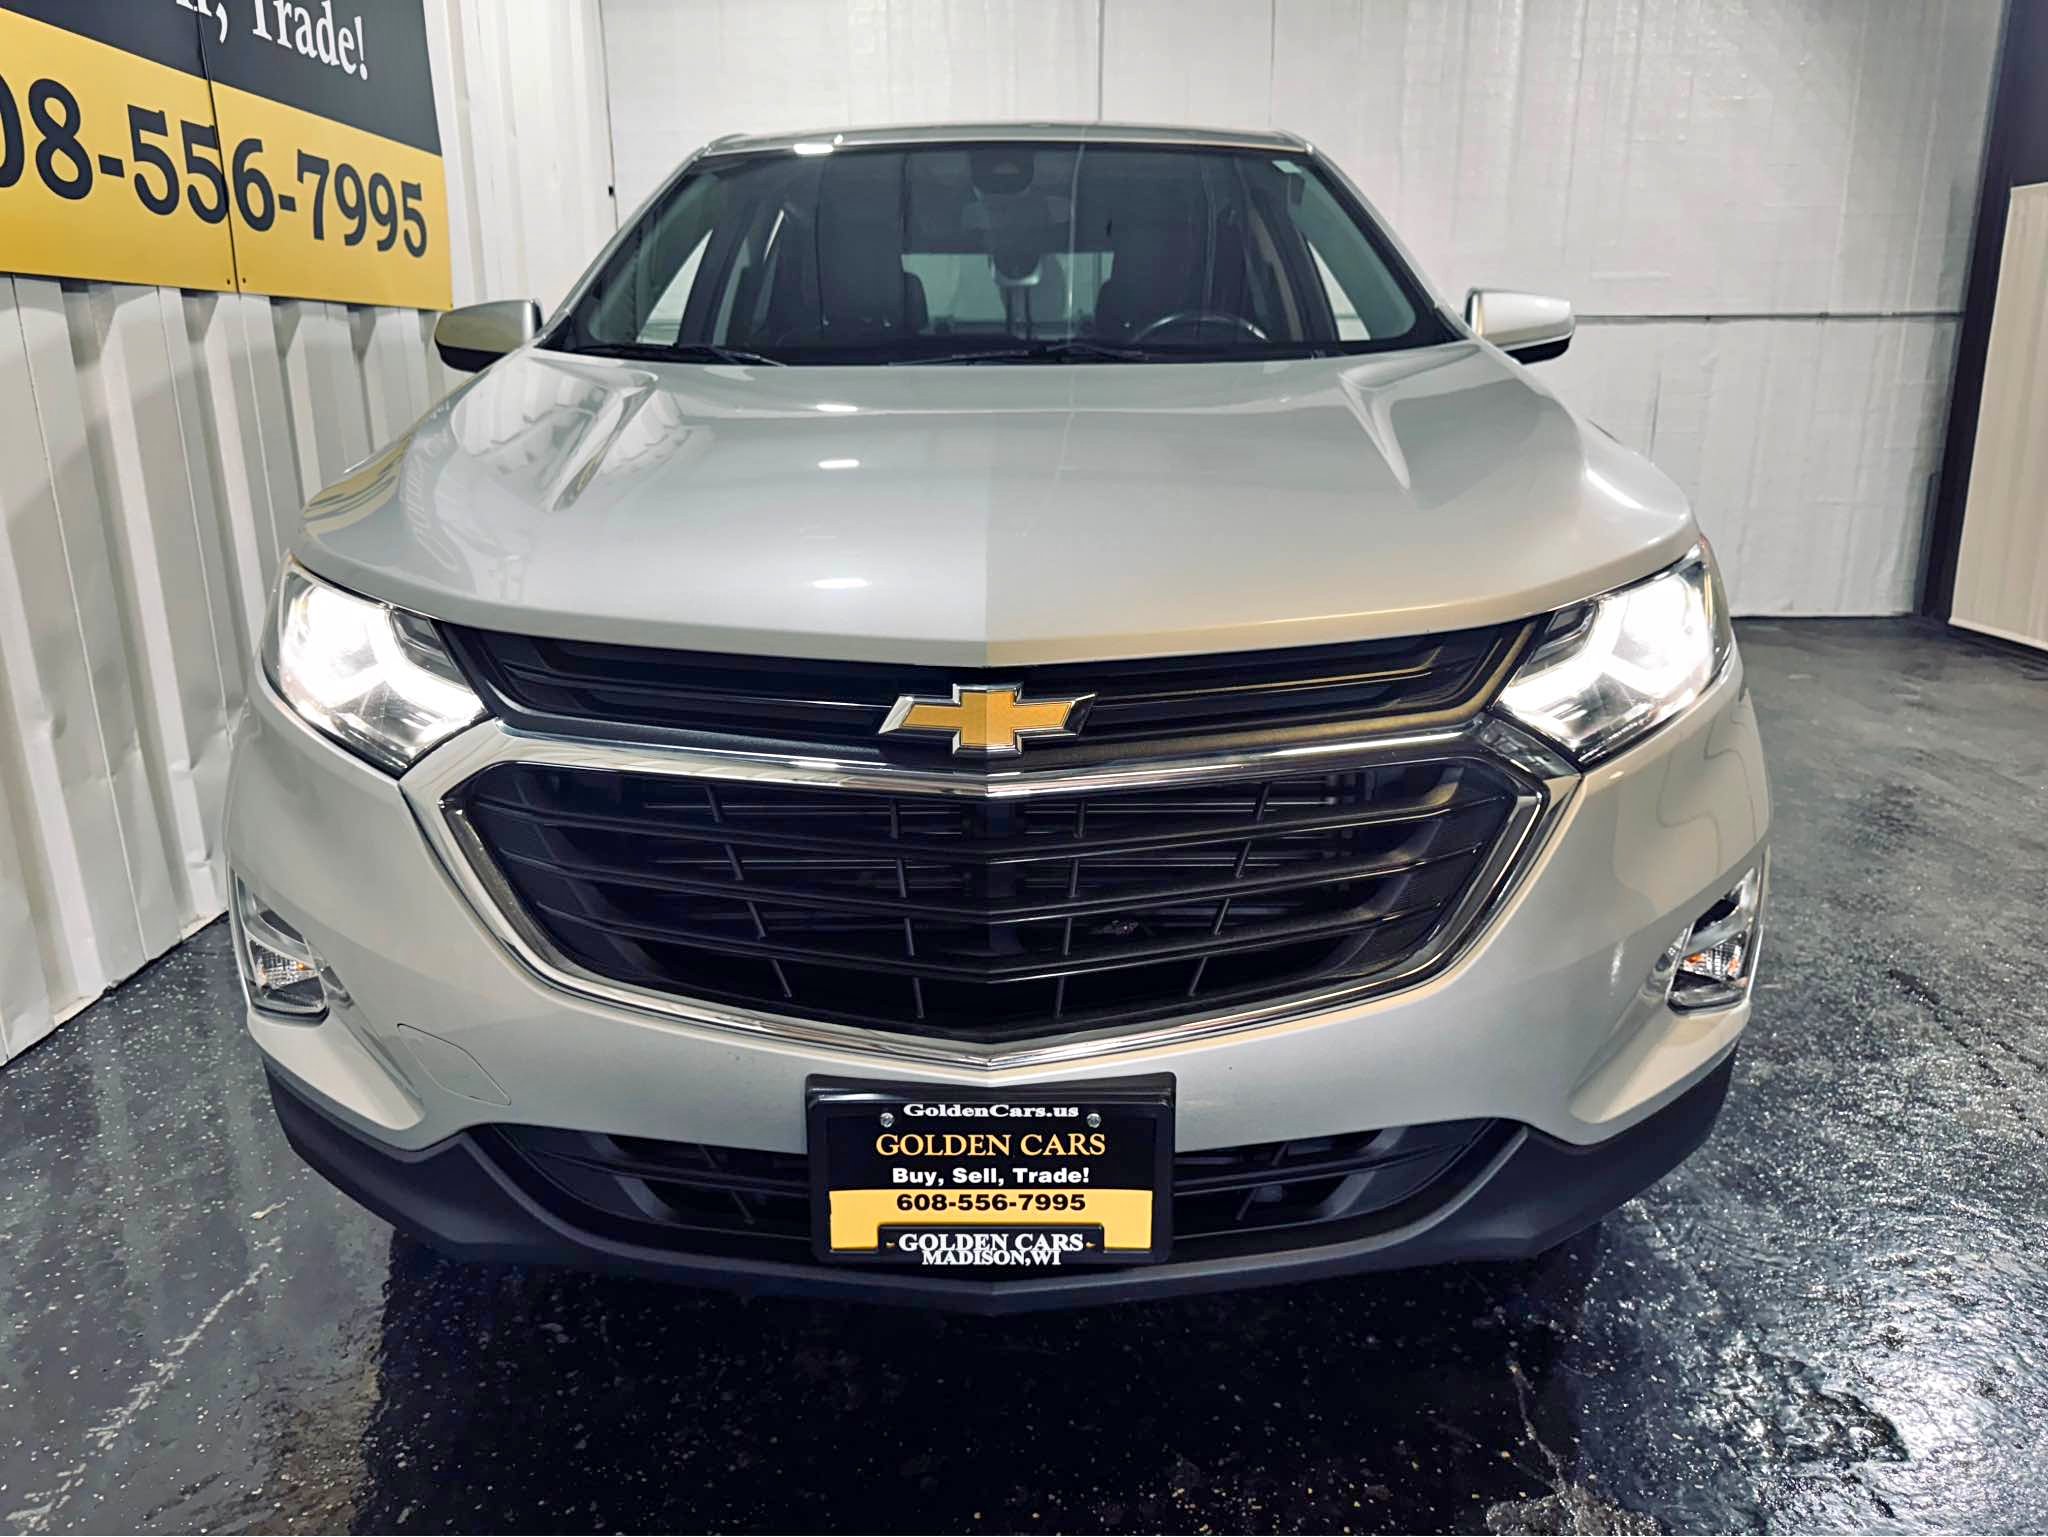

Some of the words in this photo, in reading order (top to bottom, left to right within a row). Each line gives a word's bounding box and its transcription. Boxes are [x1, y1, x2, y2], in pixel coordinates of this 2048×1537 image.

[903, 1103, 1079, 1118] GoldenCars.us
[876, 1134, 1012, 1156] GOLDEN
[1020, 1133, 1106, 1156] CARS
[892, 1168, 944, 1186] Buy,
[952, 1168, 1004, 1186] Sell,
[1012, 1167, 1090, 1184] Trade!
[896, 1193, 1086, 1211] 608-556-7995
[898, 1233, 1008, 1251] GOLDEN
[1014, 1233, 1084, 1251] CARS
[921, 1249, 1062, 1266] MADISON,WI
